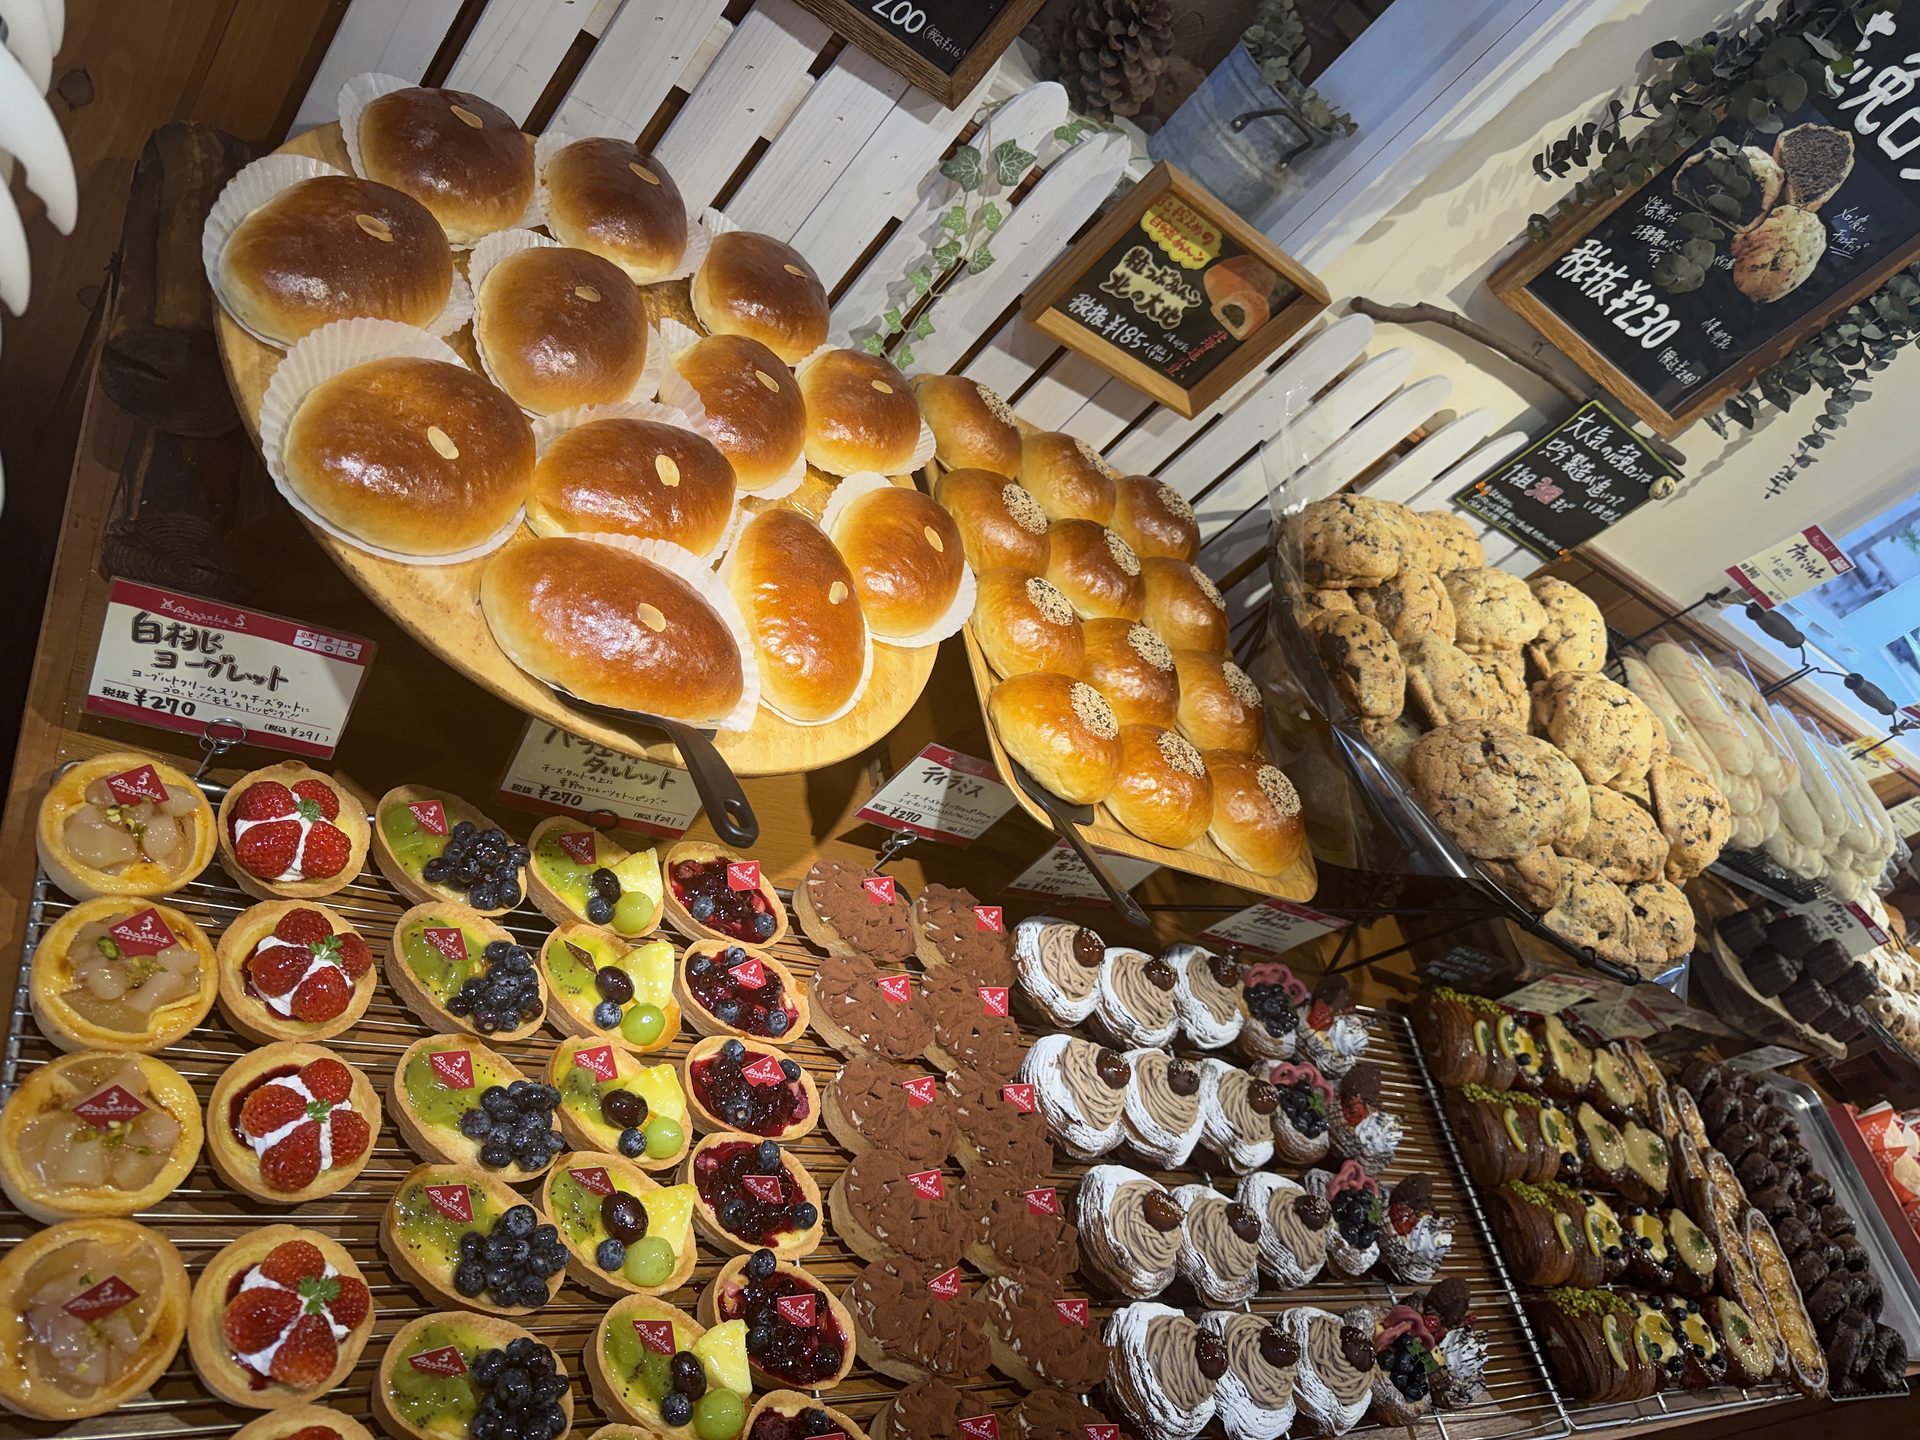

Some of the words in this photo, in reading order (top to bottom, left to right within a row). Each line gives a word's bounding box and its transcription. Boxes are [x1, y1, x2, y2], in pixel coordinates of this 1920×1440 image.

[1107, 272, 1181, 325] 北の大地
[1556, 238, 1630, 306] 税抜
[1603, 279, 1681, 349] ¥230
[1068, 294, 1110, 330] 税抜
[131, 610, 224, 654] 白桃
[150, 649, 289, 691] ヨーグレット
[101, 686, 130, 701] 税抜
[132, 688, 197, 718] ¥270
[582, 757, 677, 790] タルレット
[922, 766, 985, 798] ティラミス
[511, 782, 533, 795] 税抜
[538, 784, 583, 807] ¥270
[888, 805, 922, 823] ¥270
